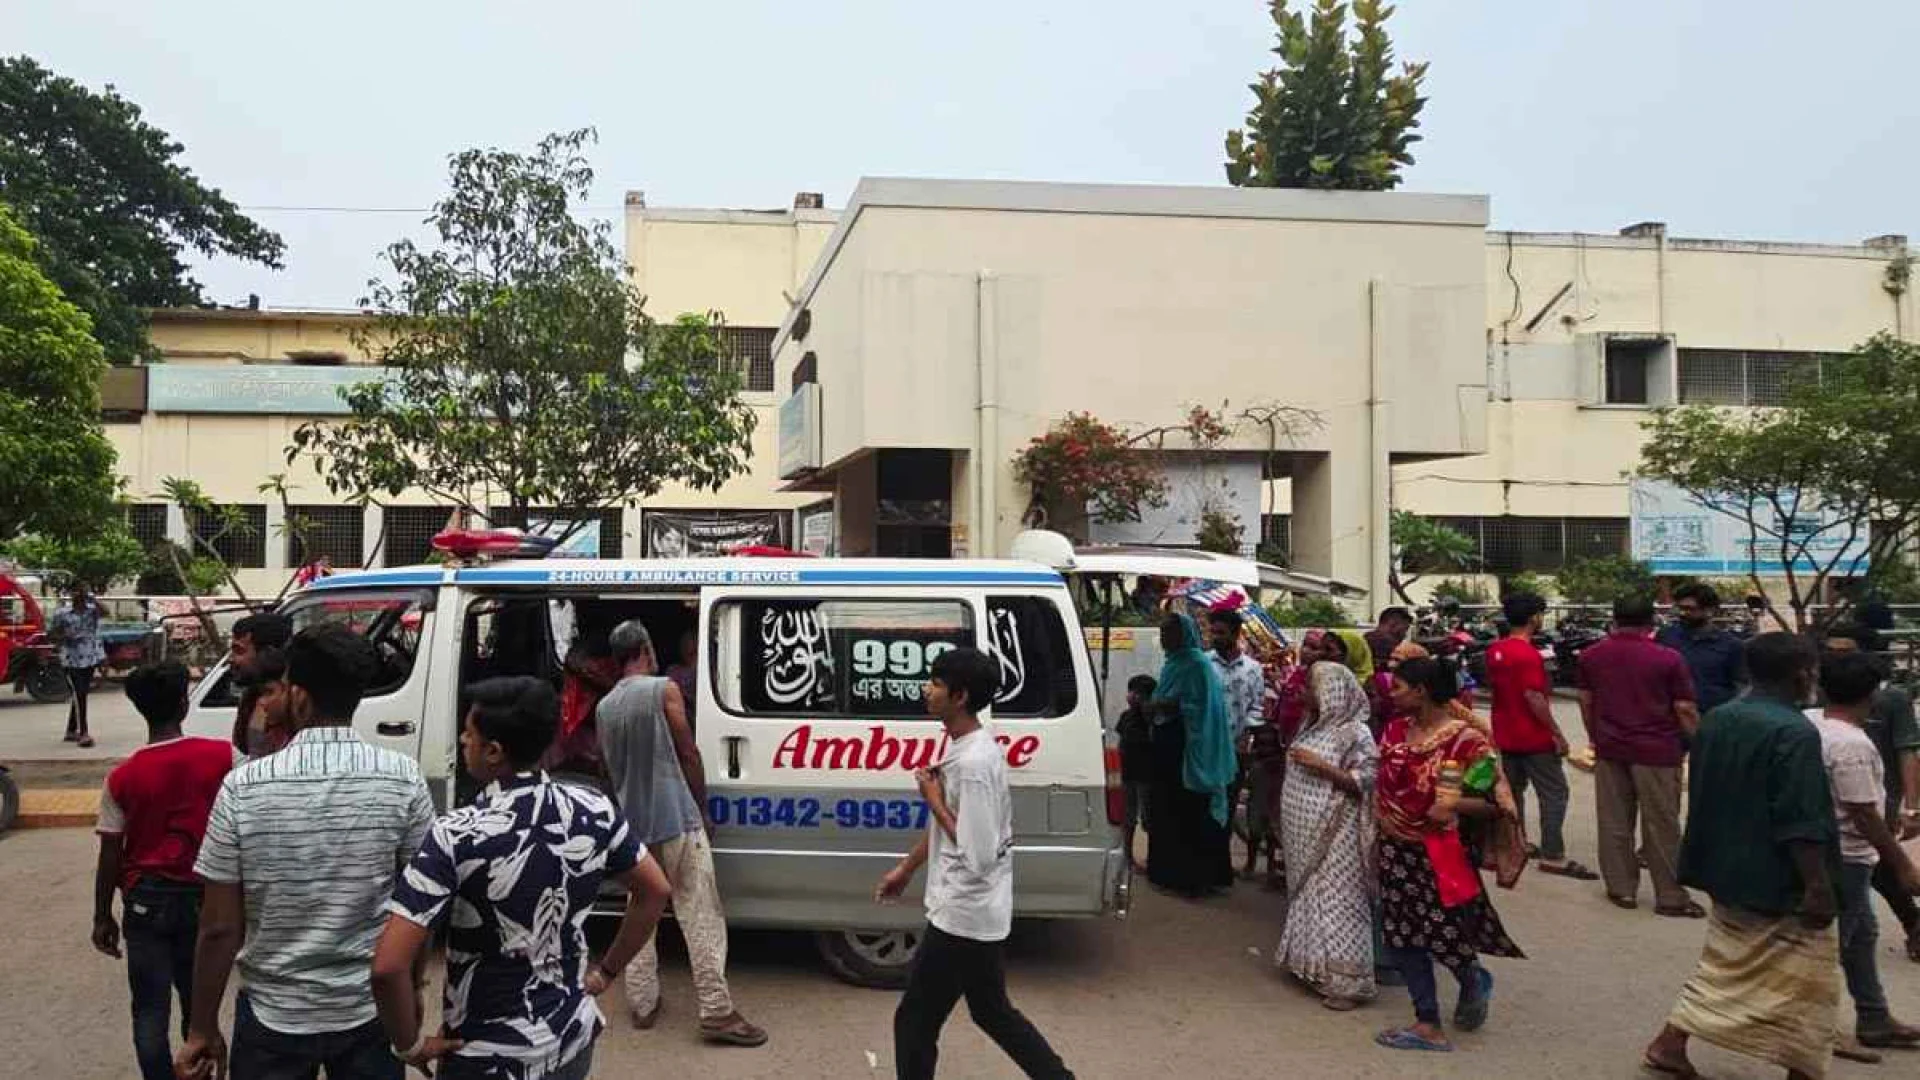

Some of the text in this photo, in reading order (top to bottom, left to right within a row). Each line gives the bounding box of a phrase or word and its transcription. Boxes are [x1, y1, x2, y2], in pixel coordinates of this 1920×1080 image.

[549, 570, 800, 583] 24-HOURS AMBULANCE SERVICE
[853, 678, 883, 701] এর
[772, 724, 1040, 770] Ambule
